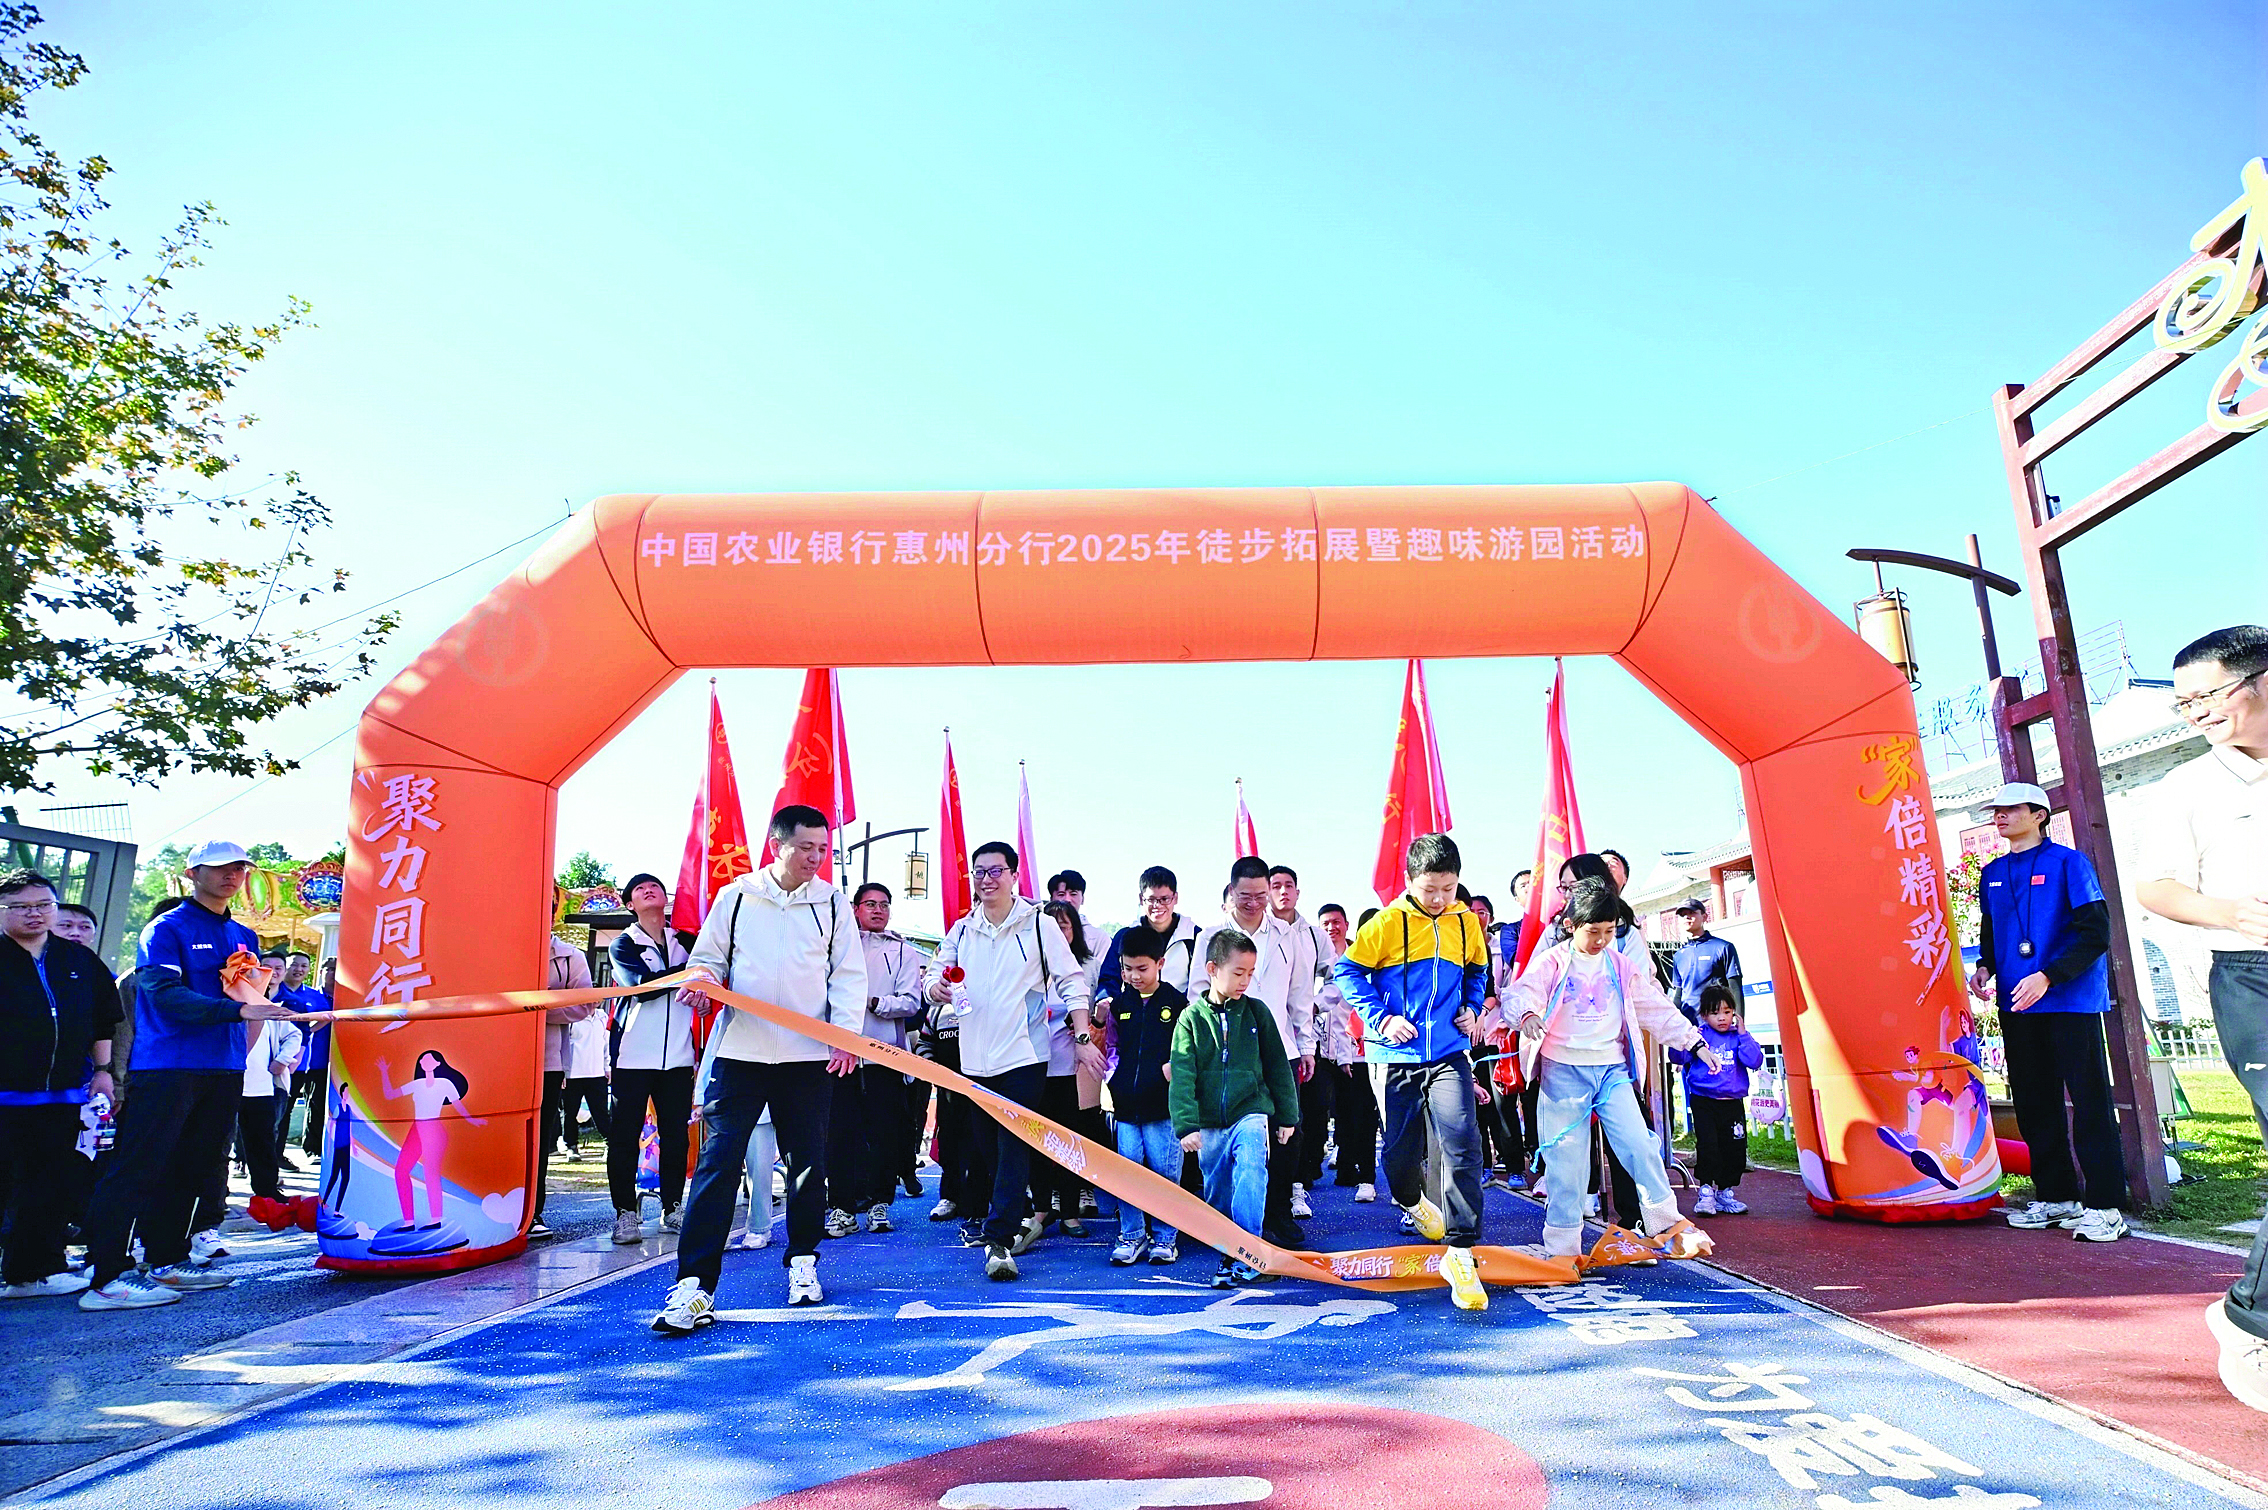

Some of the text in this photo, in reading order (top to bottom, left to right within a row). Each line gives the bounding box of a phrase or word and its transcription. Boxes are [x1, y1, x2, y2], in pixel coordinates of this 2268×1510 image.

[640, 523, 1646, 568] 中国农业银行惠州分行2025年徒步拓展暨趣味游园活动
[361, 774, 443, 1034] 聚力同行
[1329, 1252, 1444, 1278] 聚力同行 “家”倍
